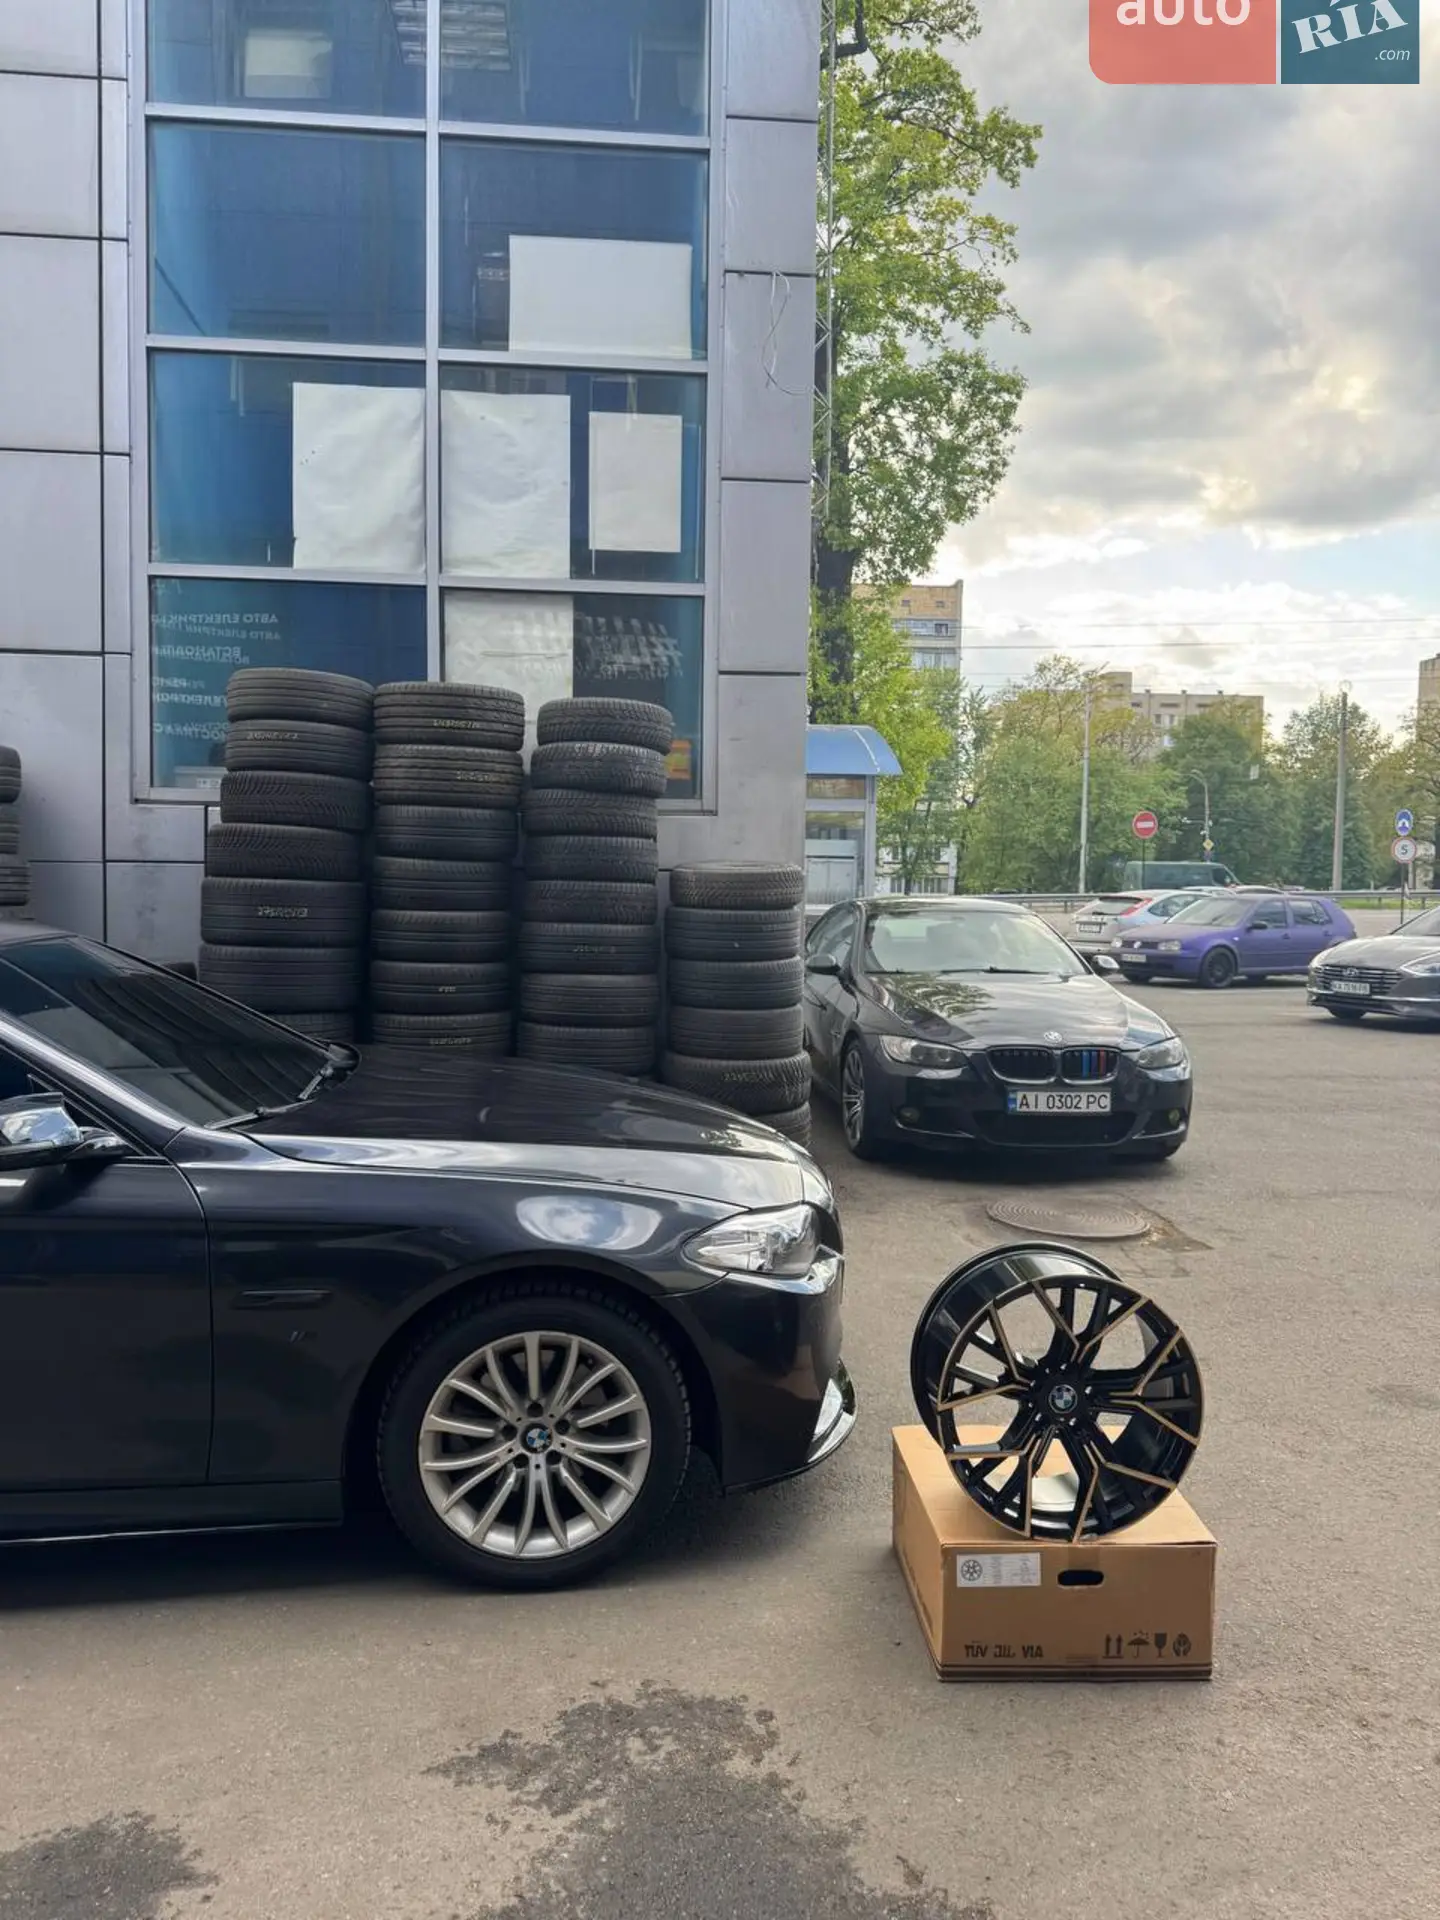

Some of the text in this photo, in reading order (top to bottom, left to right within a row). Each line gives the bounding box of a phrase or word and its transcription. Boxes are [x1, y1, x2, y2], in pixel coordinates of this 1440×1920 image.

[1400, 843, 1409, 856] 5
[1018, 1094, 1039, 1109] AI
[1046, 1094, 1082, 1110] 0302
[1085, 1094, 1109, 1110] PC
[1021, 1644, 1044, 1659] VIA
